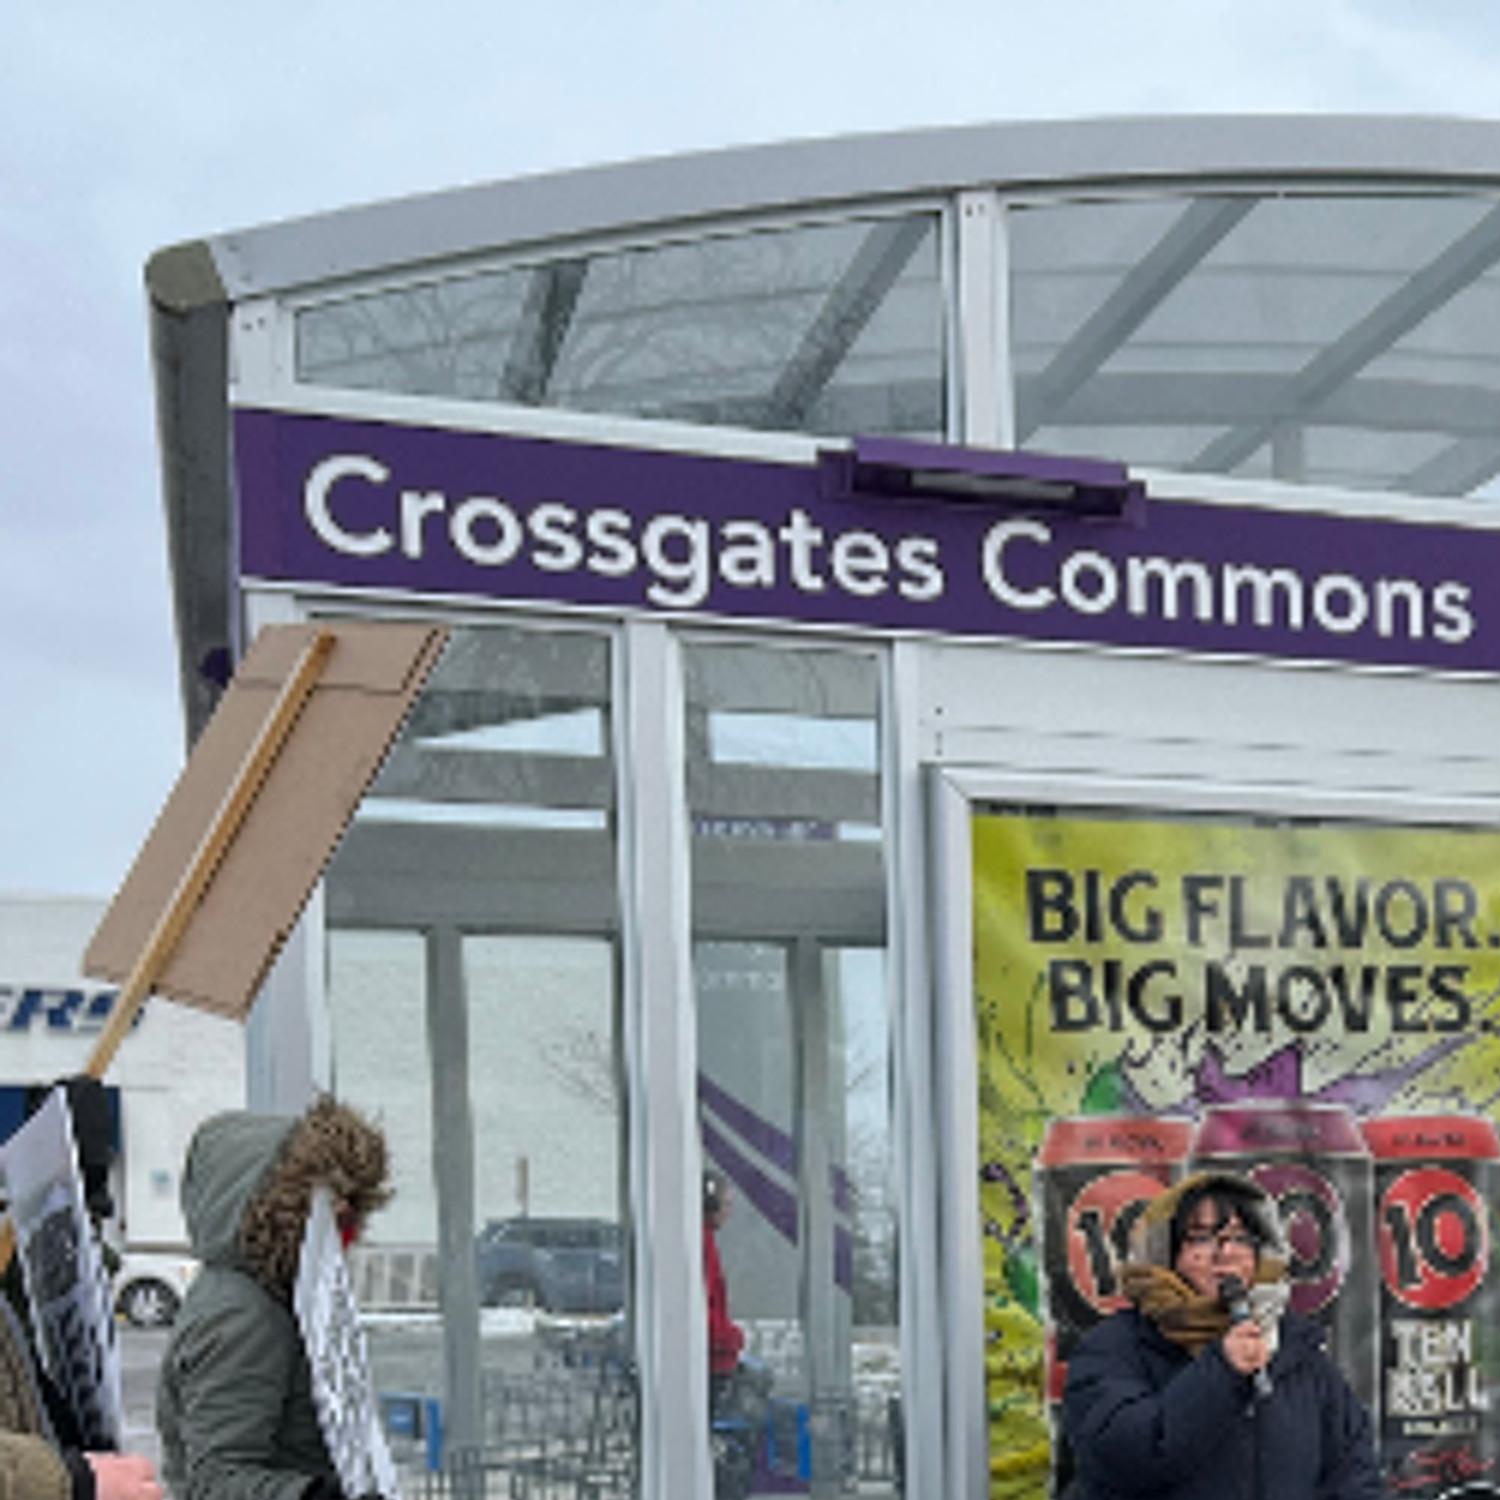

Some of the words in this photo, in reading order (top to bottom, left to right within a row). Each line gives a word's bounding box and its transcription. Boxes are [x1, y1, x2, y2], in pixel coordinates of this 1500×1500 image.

[304, 455, 944, 607] Crossgates
[982, 520, 1474, 643] Commons
[1026, 869, 1163, 944] BIG
[1049, 958, 1184, 1033] BIG
[1204, 963, 1493, 1034] MOVES.
[1383, 1192, 1481, 1290] 10
[1390, 1318, 1473, 1364] TEN
